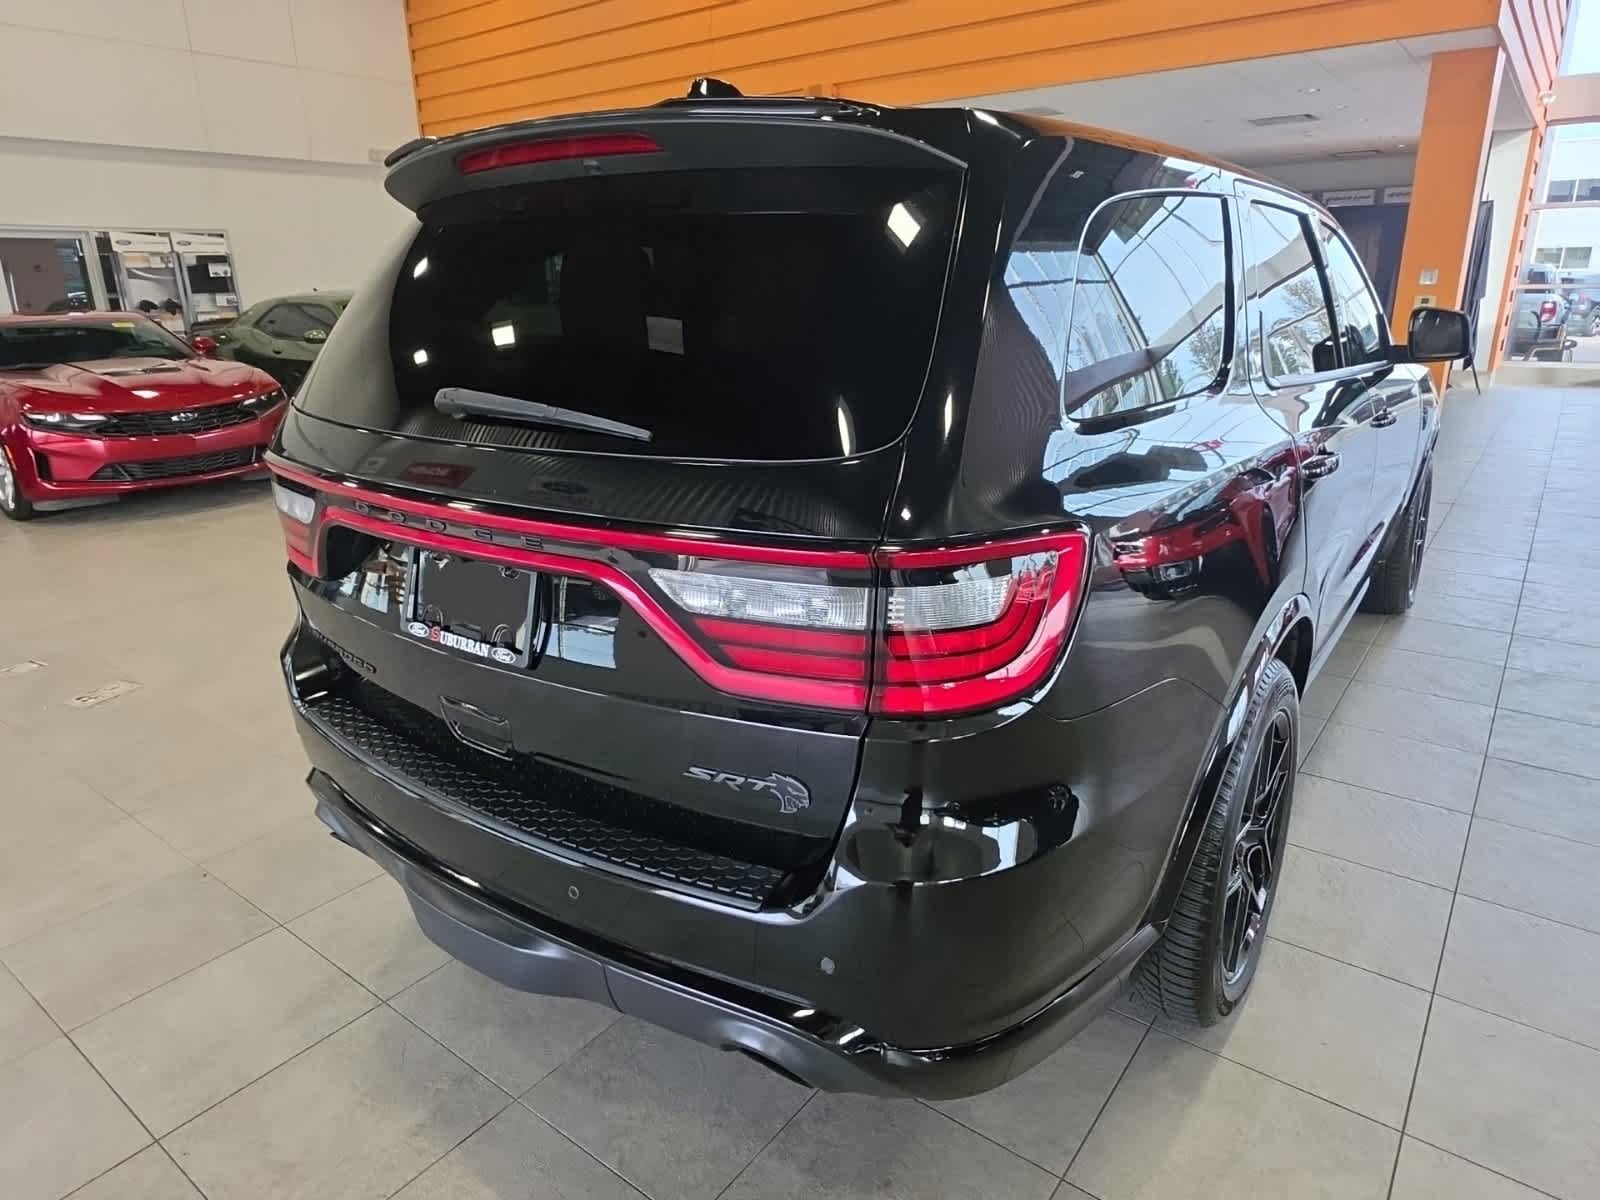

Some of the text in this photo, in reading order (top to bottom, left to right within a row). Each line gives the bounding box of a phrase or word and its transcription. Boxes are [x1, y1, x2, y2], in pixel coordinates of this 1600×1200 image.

[354, 500, 545, 550] DODGE
[431, 626, 490, 657] SUBURBAN
[683, 765, 777, 792] SRT
